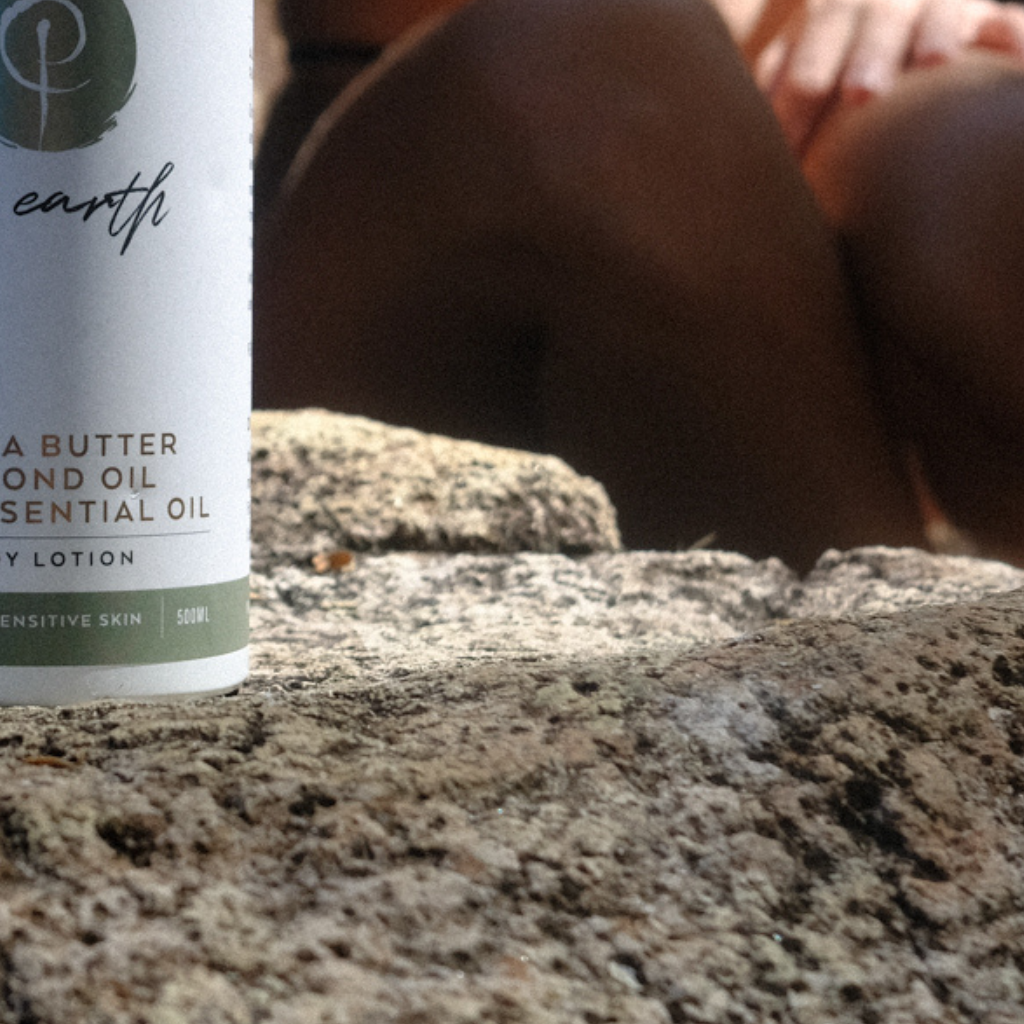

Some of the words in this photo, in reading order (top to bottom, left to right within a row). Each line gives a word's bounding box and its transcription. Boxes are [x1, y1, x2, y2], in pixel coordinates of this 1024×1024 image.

[12, 161, 174, 256] earth
[41, 432, 177, 457] BUTTER
[101, 466, 156, 490] OIL
[167, 496, 210, 519] OIL
[34, 550, 134, 567] LOTION
[99, 612, 142, 627] SKIN
[177, 606, 210, 625] 500ML
